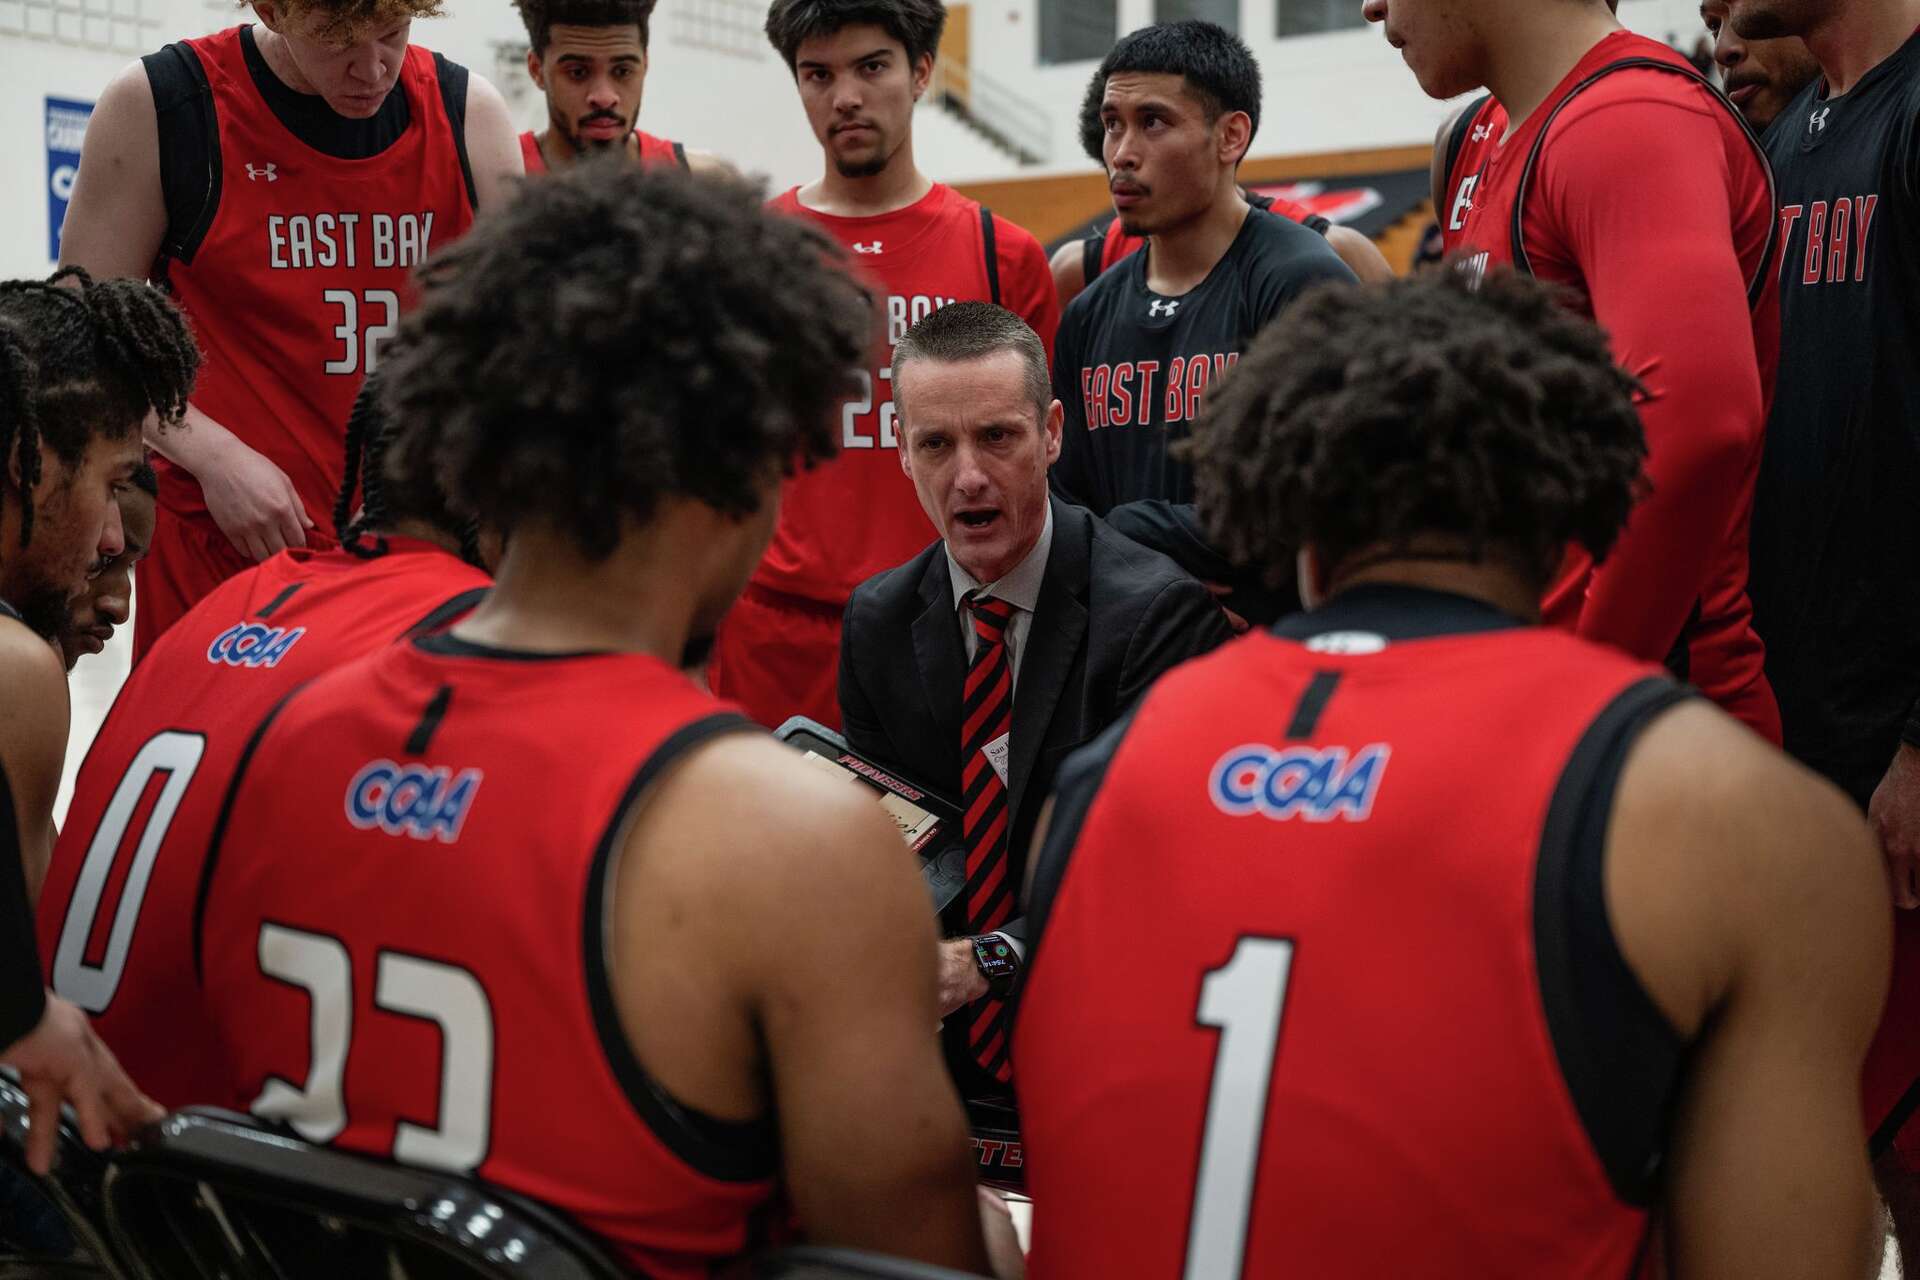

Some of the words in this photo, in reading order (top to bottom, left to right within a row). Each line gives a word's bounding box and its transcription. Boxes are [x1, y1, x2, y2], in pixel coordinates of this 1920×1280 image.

[268, 213, 360, 269] EAST
[372, 212, 434, 268] BAY
[1803, 194, 1879, 285] BAY
[323, 288, 400, 375] 32
[887, 295, 956, 346] BA
[1081, 360, 1160, 432] EAST
[1208, 743, 1391, 823] CCAA
[51, 729, 206, 1016] 0
[1183, 934, 1296, 1280] 1
